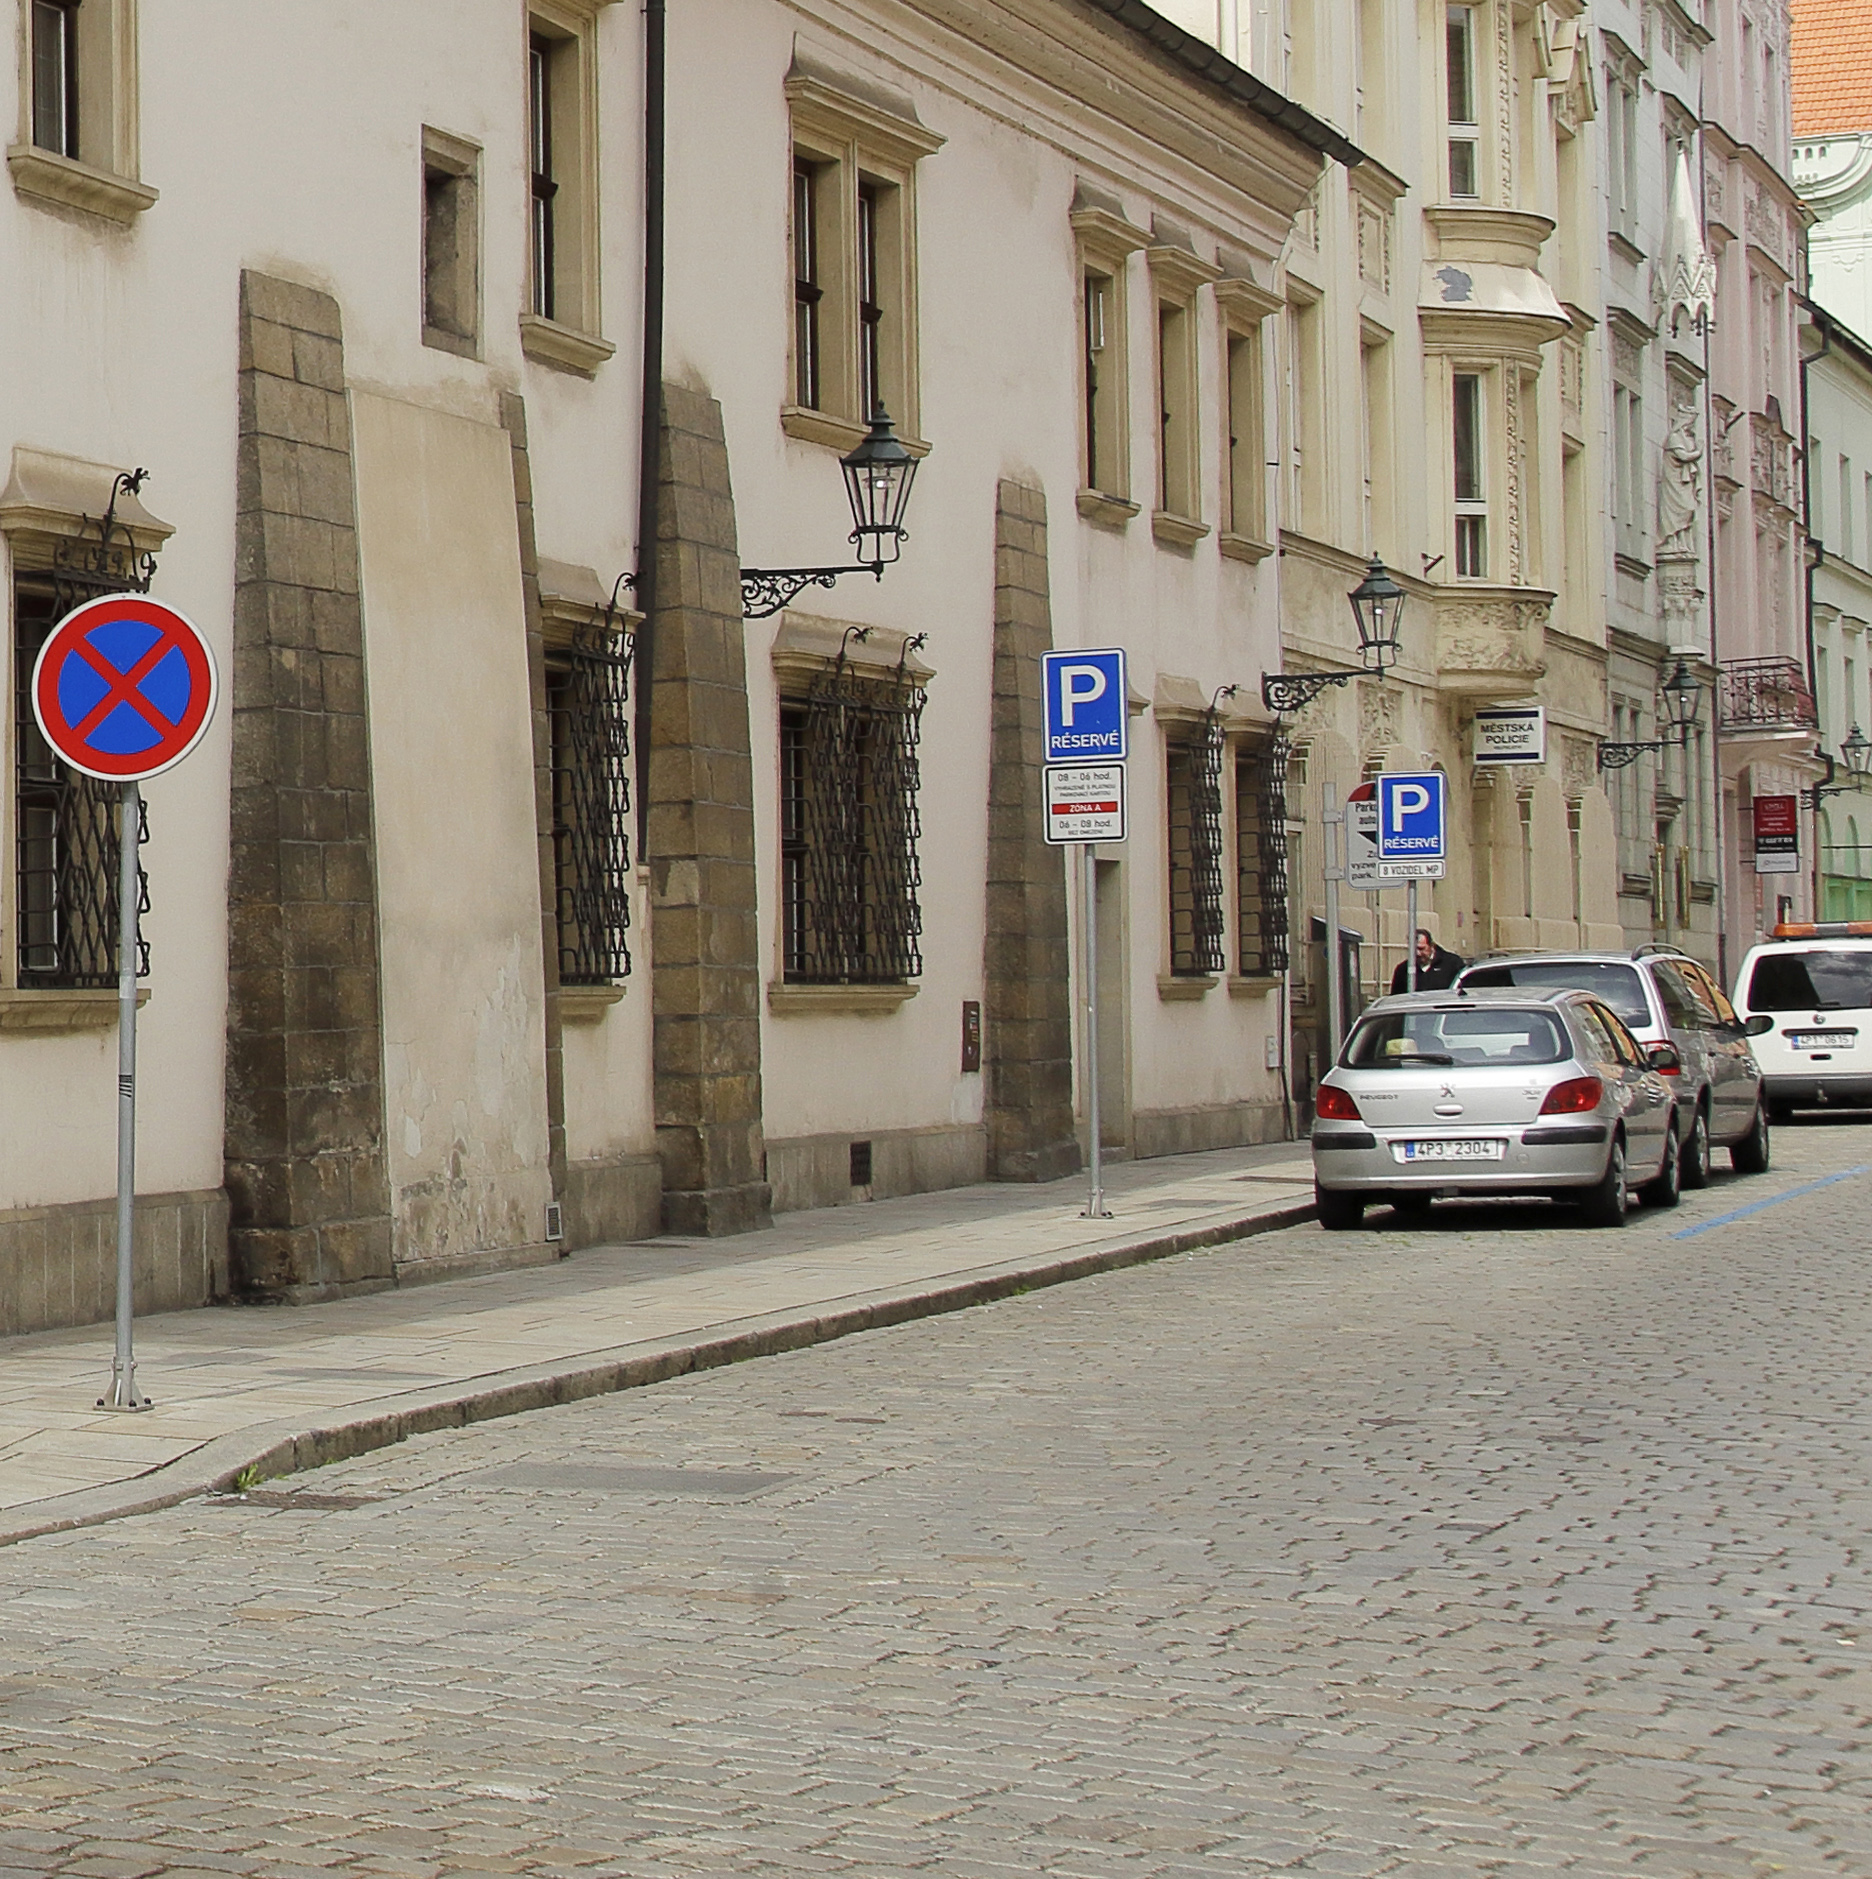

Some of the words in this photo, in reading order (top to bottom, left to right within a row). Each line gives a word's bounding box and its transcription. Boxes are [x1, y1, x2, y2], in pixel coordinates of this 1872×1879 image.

[1060, 665, 1106, 727] P
[1480, 720, 1535, 733] MĚSTSKÁ
[1051, 730, 1120, 749] RÉSERVÉ
[1485, 734, 1530, 744] POLICIE
[1093, 772, 1113, 780] hod.
[1069, 802, 1093, 813] ZÓNA
[1094, 803, 1102, 811] A
[1392, 784, 1430, 833] P
[1094, 820, 1113, 828] hod.
[1383, 835, 1439, 849] RÉSERVÉ
[1417, 1142, 1444, 1156] 4P3
[1455, 1141, 1491, 1155] 2304
